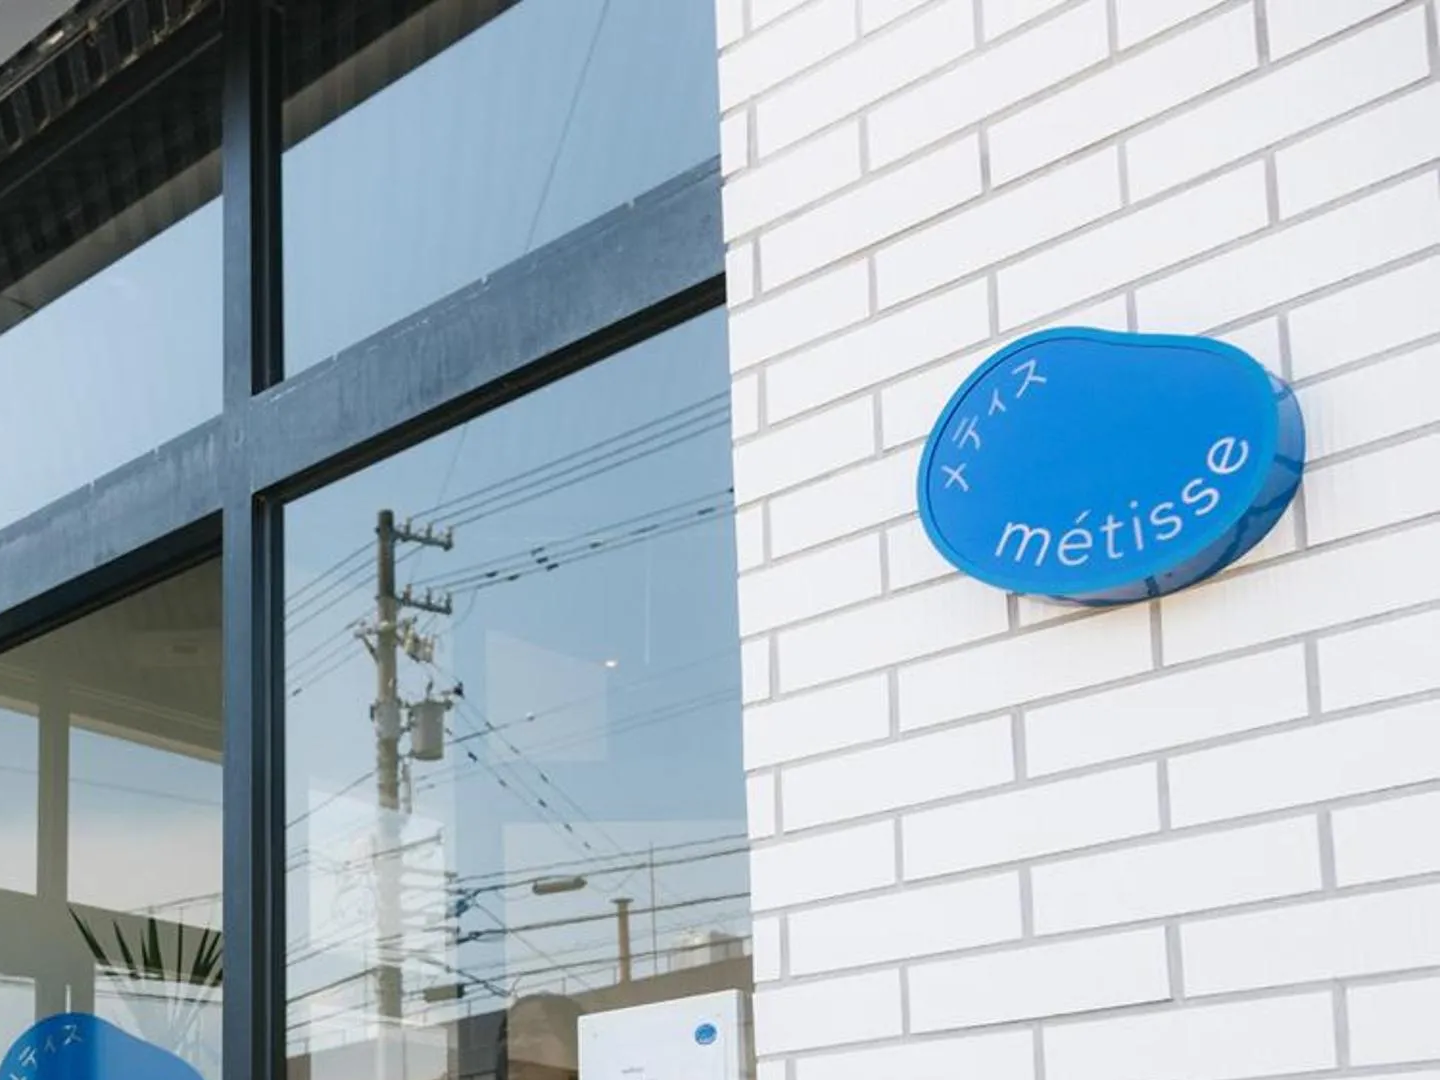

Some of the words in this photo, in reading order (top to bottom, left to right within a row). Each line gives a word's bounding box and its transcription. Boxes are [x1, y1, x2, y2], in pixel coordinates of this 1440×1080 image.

[944, 359, 1047, 492] メティス
[994, 436, 1249, 568] métisse
